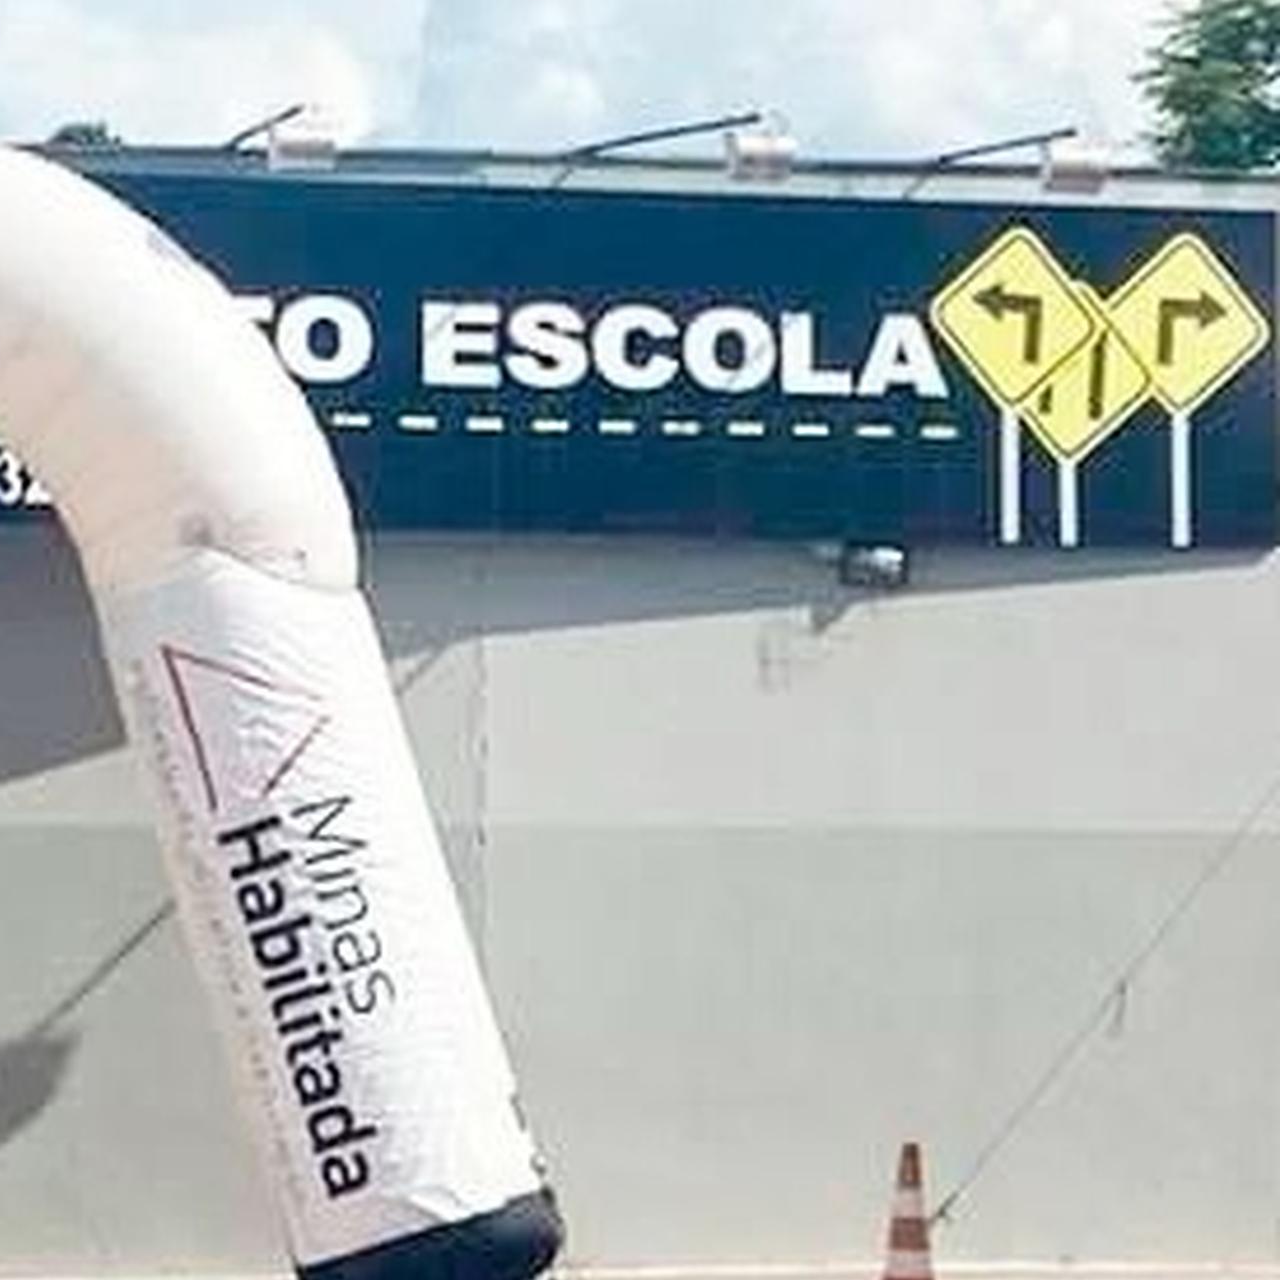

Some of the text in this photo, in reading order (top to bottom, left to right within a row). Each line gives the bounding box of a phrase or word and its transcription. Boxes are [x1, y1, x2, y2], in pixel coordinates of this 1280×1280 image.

[421, 300, 949, 398] ESCOLA
[216, 814, 379, 1202] Habilitada
[290, 793, 397, 1016] Minas
